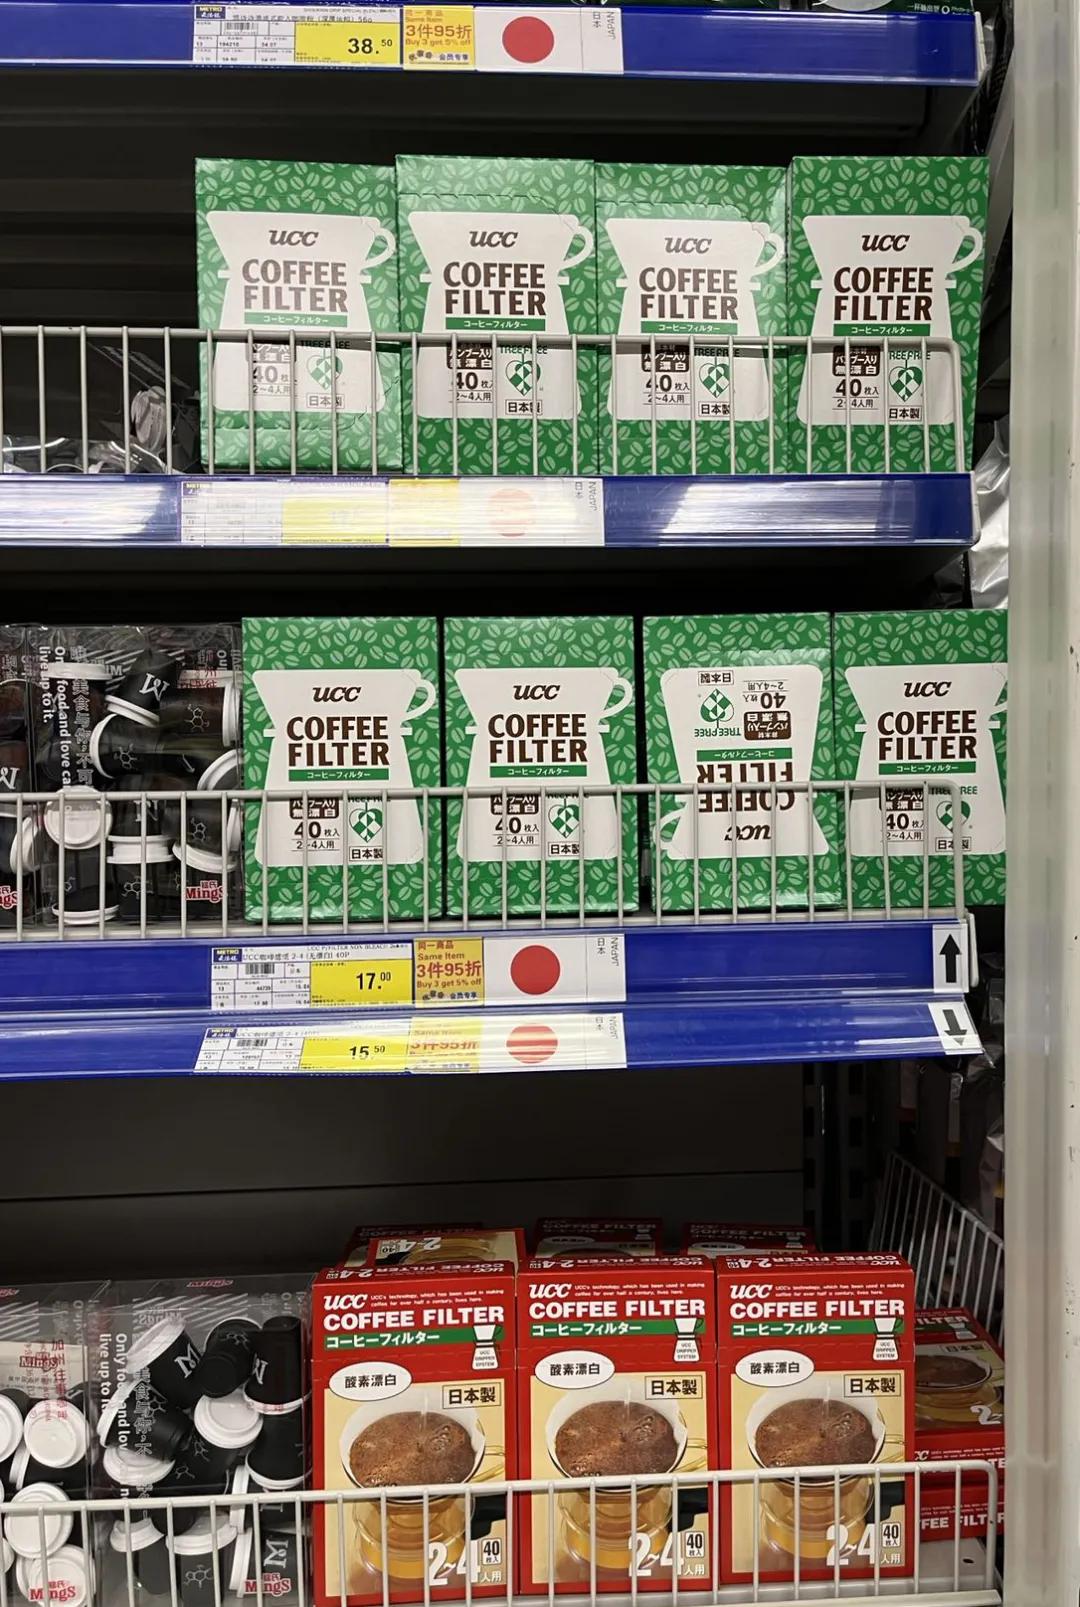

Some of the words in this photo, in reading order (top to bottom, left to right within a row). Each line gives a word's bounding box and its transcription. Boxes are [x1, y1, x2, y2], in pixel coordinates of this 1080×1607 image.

[406, 24, 472, 39] 3件95折
[242, 258, 347, 286] COFFEE
[443, 262, 545, 288] COFFEE
[639, 267, 737, 293] COFFEE
[834, 266, 933, 293] COFFEE
[244, 285, 348, 312] FILTER
[445, 290, 546, 315] FILTER
[641, 294, 738, 320] FILTER
[834, 296, 932, 320] FILTER
[264, 314, 329, 324] コーヒーフィルター
[658, 324, 720, 332] コーヒーフィルター
[835, 379, 862, 396] 40
[889, 408, 920, 418] 日本製
[42, 692, 53, 707] to
[56, 680, 70, 710] food
[761, 692, 786, 709] 40
[58, 710, 71, 736] and
[287, 716, 388, 741] COFFEE
[488, 714, 586, 737] COFFEE
[878, 710, 976, 735] COFFEE
[60, 740, 72, 768] love
[288, 742, 390, 766] FILTER
[490, 739, 587, 763] FILTER
[879, 736, 976, 760] FILTER
[307, 771, 370, 779] コーヒーフィルター
[294, 821, 321, 838] 40
[495, 817, 521, 833] 40
[886, 813, 909, 830] 40
[352, 849, 383, 859] 日本製
[445, 952, 464, 960] Item
[417, 960, 481, 979] 3件95折
[441, 980, 454, 988] get
[324, 1310, 415, 1330] COFFEE
[423, 1306, 504, 1326] FILTER
[529, 1302, 617, 1319] COFFEE
[626, 1300, 705, 1316] FILTER
[730, 1302, 817, 1319] COFFEE
[826, 1300, 904, 1316] FILTER
[733, 1323, 841, 1335] コーヒーフィルター
[917, 1316, 969, 1325] ILTER
[532, 1323, 642, 1336] コーヒーフィルター
[326, 1332, 439, 1348] コーヒーフィルター
[98, 1360, 109, 1378] up
[550, 1363, 600, 1376] 酸素漂白
[750, 1362, 800, 1374] 酸素漂白
[101, 1382, 111, 1396] to
[345, 1374, 396, 1388] 酸素漂白
[652, 1380, 697, 1395] 日本製
[850, 1378, 896, 1393] 日本製
[449, 1387, 496, 1404] 日本製
[883, 1525, 898, 1539] 40
[483, 1540, 500, 1556] 40
[687, 1534, 702, 1549] 40
[880, 1554, 901, 1564] 人用
[480, 1571, 502, 1583] 人用
[684, 1564, 705, 1575] 人用
